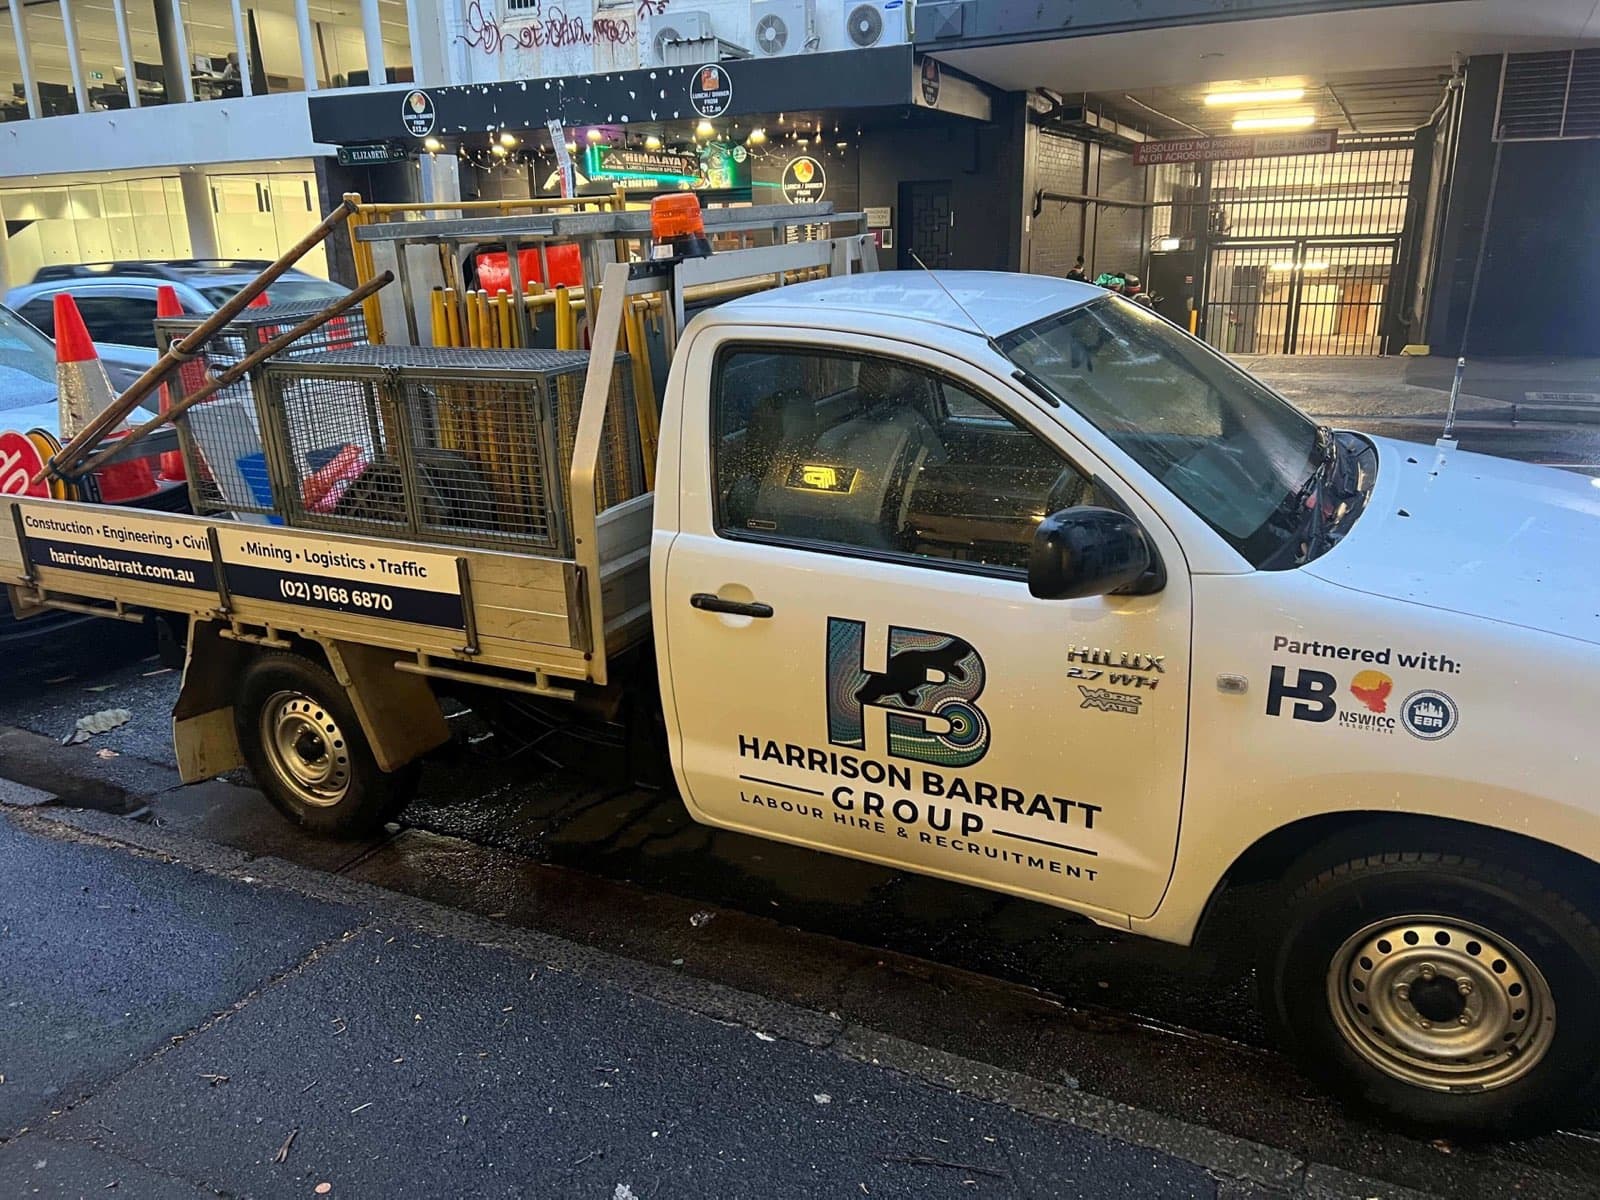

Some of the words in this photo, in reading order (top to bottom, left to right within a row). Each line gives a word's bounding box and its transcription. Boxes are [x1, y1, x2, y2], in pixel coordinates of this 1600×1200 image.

[1139, 153, 1146, 162] IN
[1149, 153, 1163, 162] OR
[1165, 150, 1201, 161] ACROSS
[1140, 142, 1194, 153] ABSOLUTELY
[1196, 140, 1210, 150] NO
[25, 515, 94, 536] Construction
[103, 525, 173, 548] Engineering
[182, 536, 210, 551] Civil
[49, 547, 195, 583] harrisonbarratt.com.au
[246, 541, 293, 563] Mining
[304, 549, 366, 570] Logistics
[378, 558, 427, 578] Traffic
[280, 578, 310, 601] (02)
[312, 584, 349, 604] 9168
[352, 590, 393, 611] 6870
[1067, 643, 1165, 674] HILUX
[1273, 635, 1391, 665] Partnered
[1397, 651, 1461, 675] with:
[1067, 666, 1104, 681] 2.7
[1077, 684, 1142, 705] WORK
[1080, 698, 1139, 715] MATE
[1266, 664, 1337, 723] HB
[1338, 710, 1396, 729] NSWICC
[1413, 715, 1442, 727] EBA
[739, 734, 912, 791] HARRISON
[922, 771, 1102, 829] BARRATT
[832, 786, 983, 837] GROUP
[740, 791, 824, 819] LABOUR
[834, 812, 886, 833] HIRE
[896, 826, 908, 839] &
[919, 831, 1097, 881] RECRUITMENT
